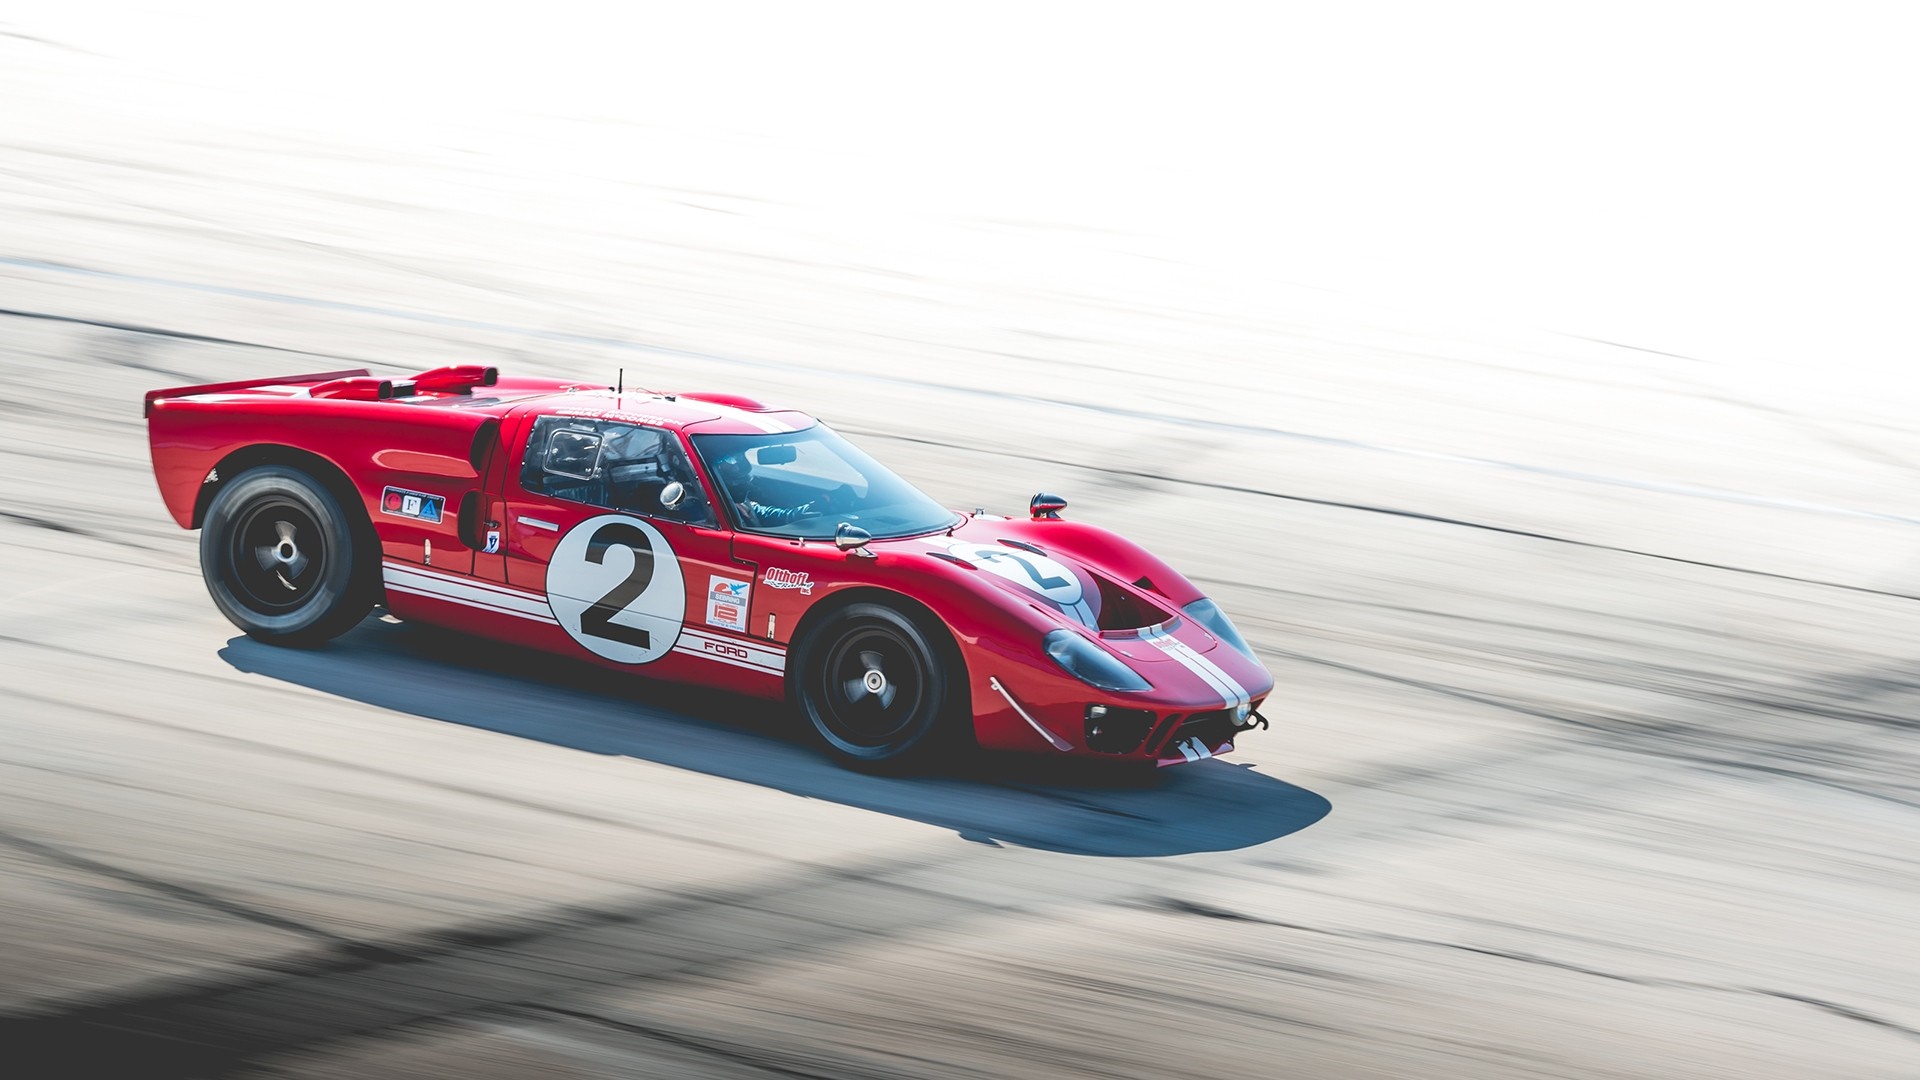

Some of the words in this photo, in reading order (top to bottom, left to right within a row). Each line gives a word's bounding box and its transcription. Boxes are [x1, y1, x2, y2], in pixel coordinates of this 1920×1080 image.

[767, 568, 807, 584] Olthoff
[975, 550, 1071, 590] 2
[580, 522, 655, 651] 2
[704, 641, 748, 659] FORD
